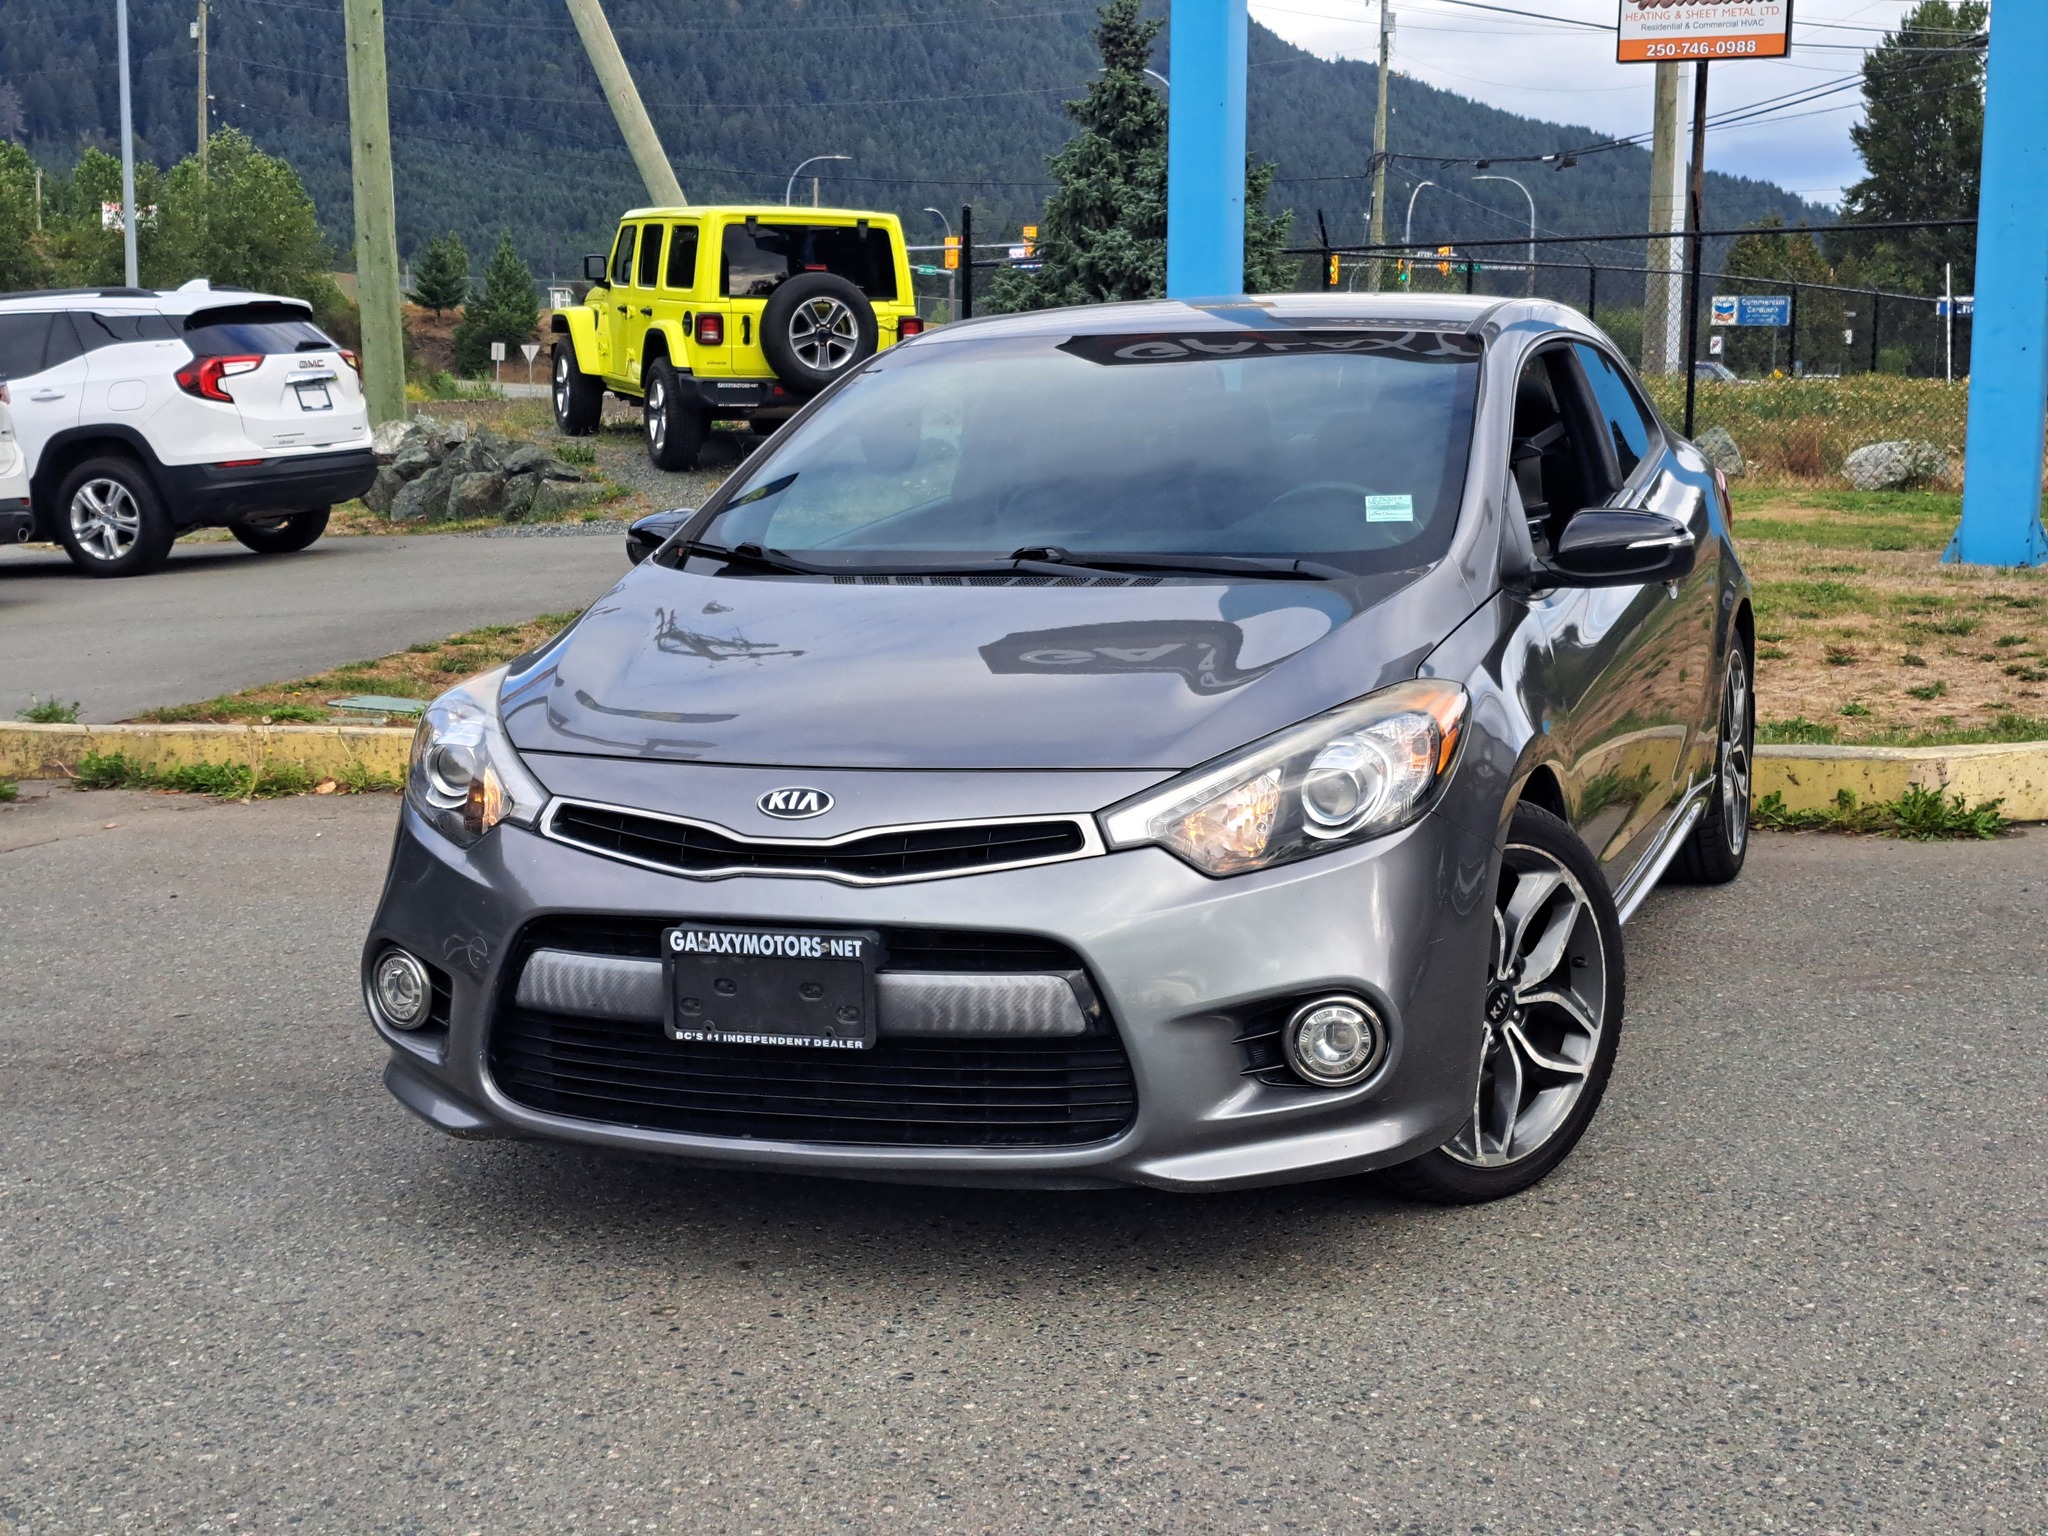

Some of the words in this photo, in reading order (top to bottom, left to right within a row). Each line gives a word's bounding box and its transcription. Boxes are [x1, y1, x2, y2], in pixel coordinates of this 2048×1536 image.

[1625, 11, 1670, 21] HEATING
[1675, 10, 1682, 19] &
[1686, 9, 1718, 19] SHEET
[1722, 7, 1756, 17] METAL
[1760, 6, 1782, 16] LTD.
[1641, 22, 1683, 31] Residential
[1693, 20, 1739, 29] Commercial
[1741, 19, 1765, 27] HVAC
[1646, 40, 1757, 57] 250-746-0988
[298, 359, 325, 369] GMC
[767, 791, 818, 811] KIA
[1489, 992, 1509, 1020] KIA
[675, 1031, 704, 1041] BC'S
[706, 1033, 719, 1042] #1
[722, 1034, 811, 1047] INDEPENDENT
[813, 1038, 863, 1049] DEALER
